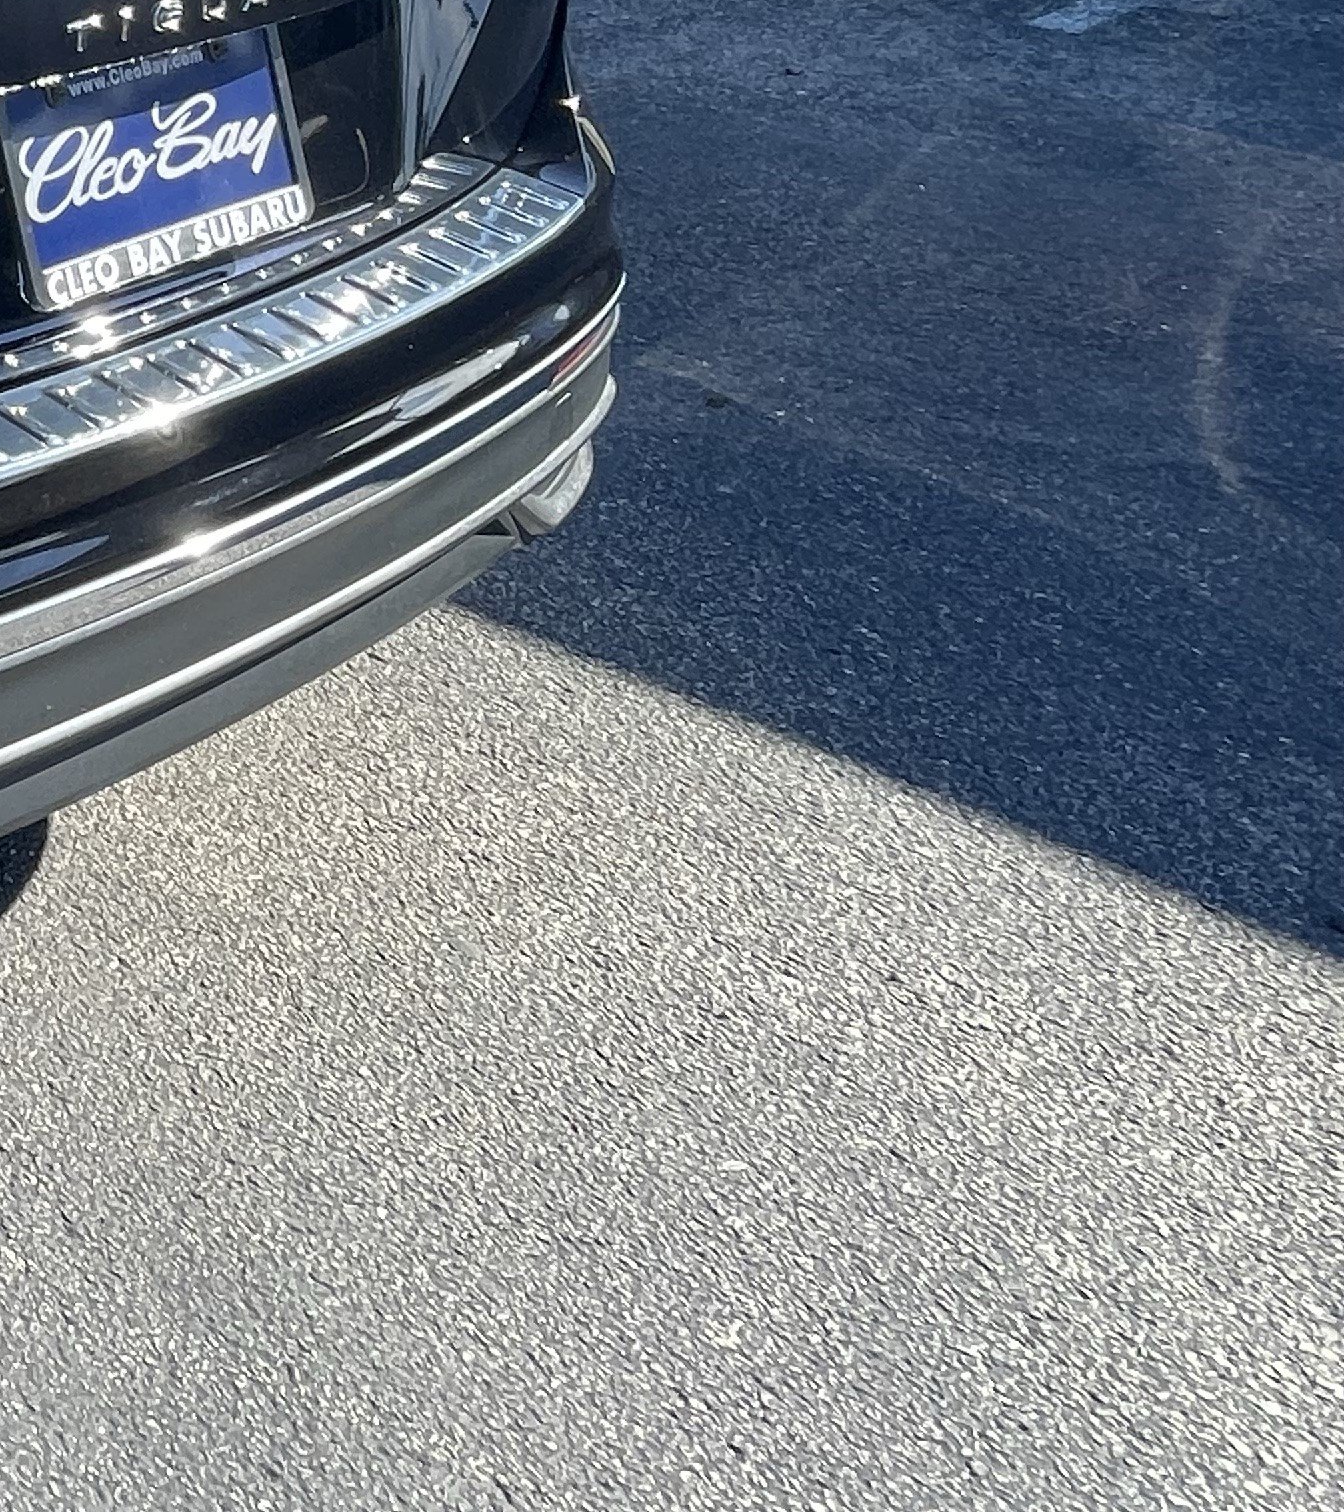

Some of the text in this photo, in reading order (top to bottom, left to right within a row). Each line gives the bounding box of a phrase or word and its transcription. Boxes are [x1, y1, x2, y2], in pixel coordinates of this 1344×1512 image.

[67, 47, 204, 98] www.CleoBay.com
[18, 92, 277, 224] Cleo Bay
[47, 187, 305, 305] CLEO BAY SUBARU
